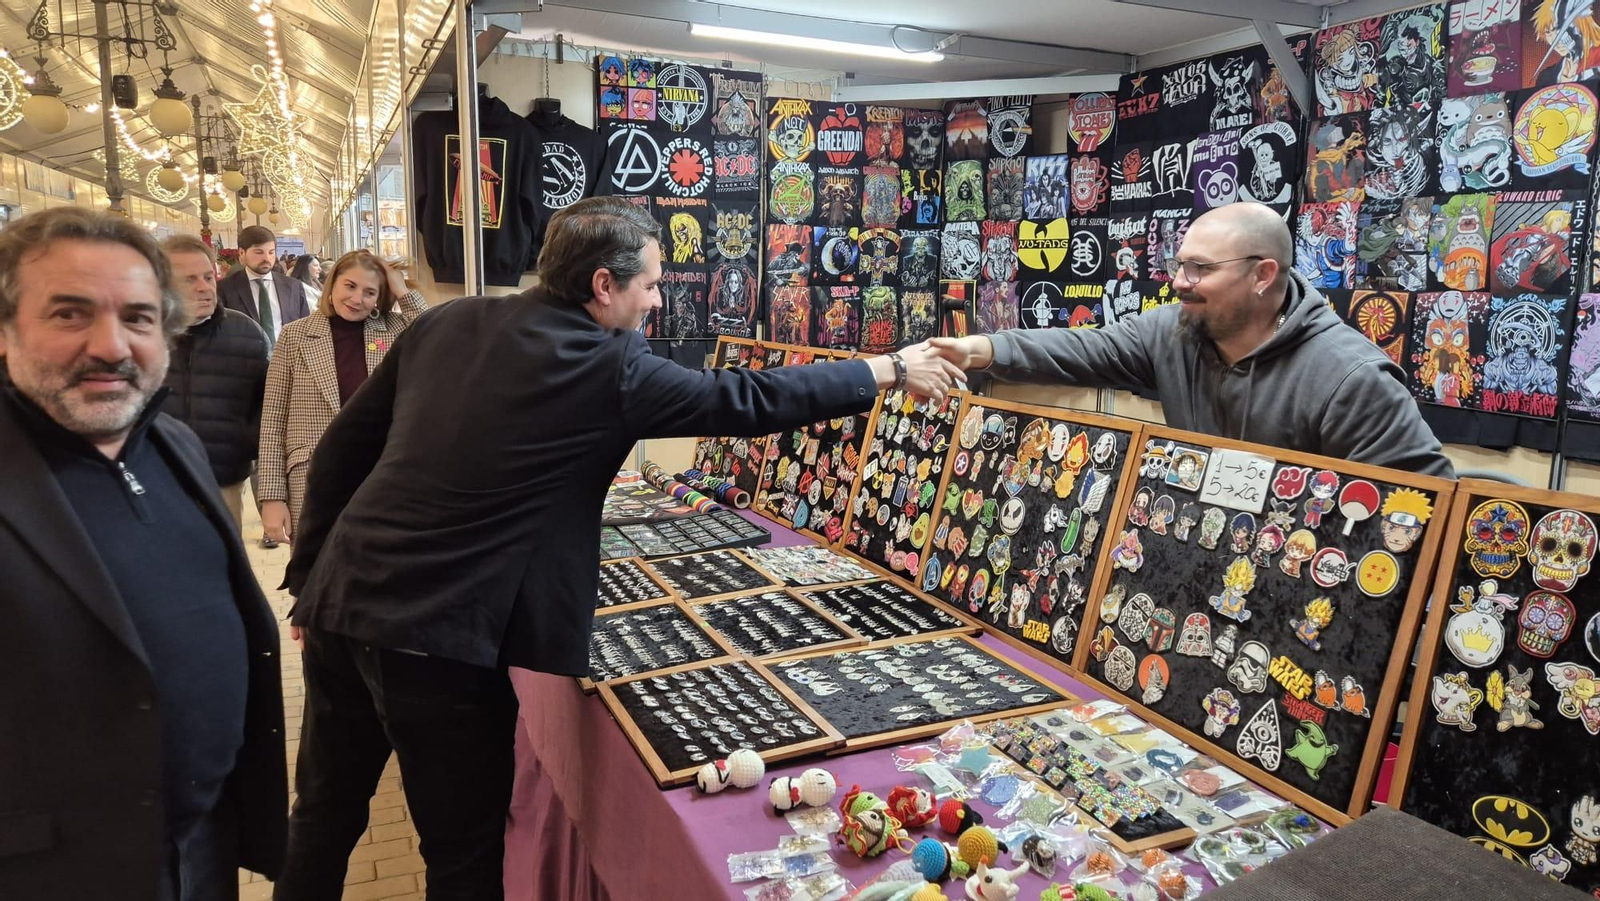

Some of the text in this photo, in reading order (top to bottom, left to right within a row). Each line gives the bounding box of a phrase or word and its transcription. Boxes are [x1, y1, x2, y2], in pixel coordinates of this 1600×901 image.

[662, 87, 700, 103] NIRVANA
[769, 98, 813, 118] ANTHRAX
[784, 116, 805, 130] NOT
[771, 161, 812, 176] ANTHRAX
[1029, 156, 1069, 175] KISS
[1535, 190, 1563, 202] ELRIC
[1018, 239, 1069, 249] WU-TANG
[830, 286, 859, 297] SKA-P
[1064, 285, 1104, 297] LOQUILLO
[1215, 454, 1267, 480] 1 5€
[1206, 476, 1260, 503] 5 20€
[1022, 624, 1051, 644] WARS
[1027, 619, 1051, 635] STAR
[1268, 660, 1305, 700] WARS
[1271, 655, 1313, 696] STAR
